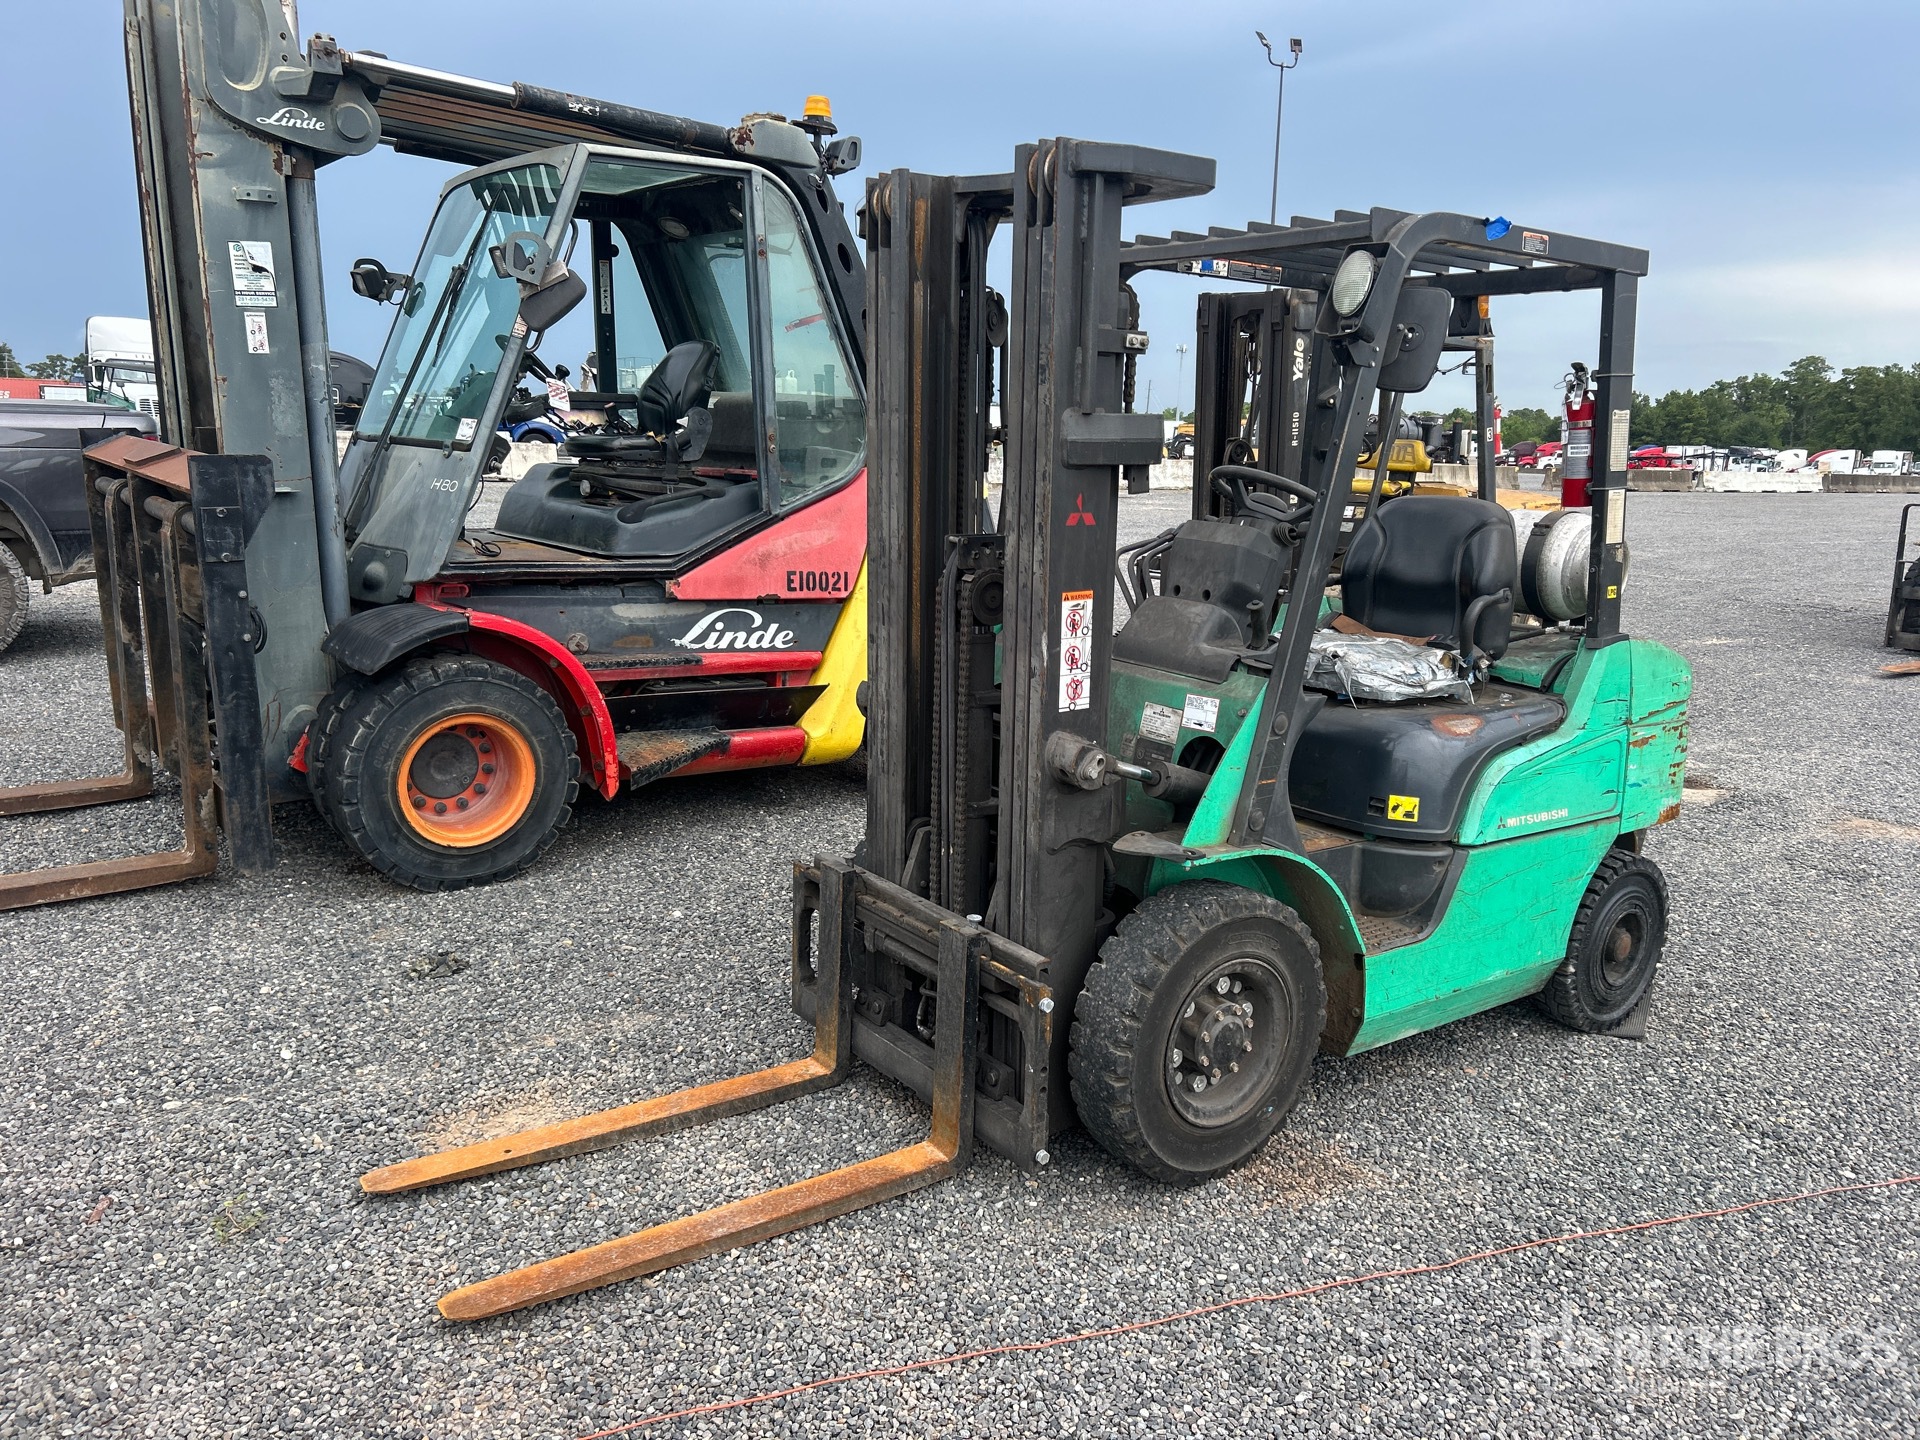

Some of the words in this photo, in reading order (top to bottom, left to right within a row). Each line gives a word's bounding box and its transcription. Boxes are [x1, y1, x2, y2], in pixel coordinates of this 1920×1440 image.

[256, 107, 325, 131] Linde
[1292, 338, 1305, 381] Yale
[430, 478, 459, 492] H80
[786, 571, 849, 593] E10021
[1070, 593, 1093, 601] WARNING
[669, 608, 794, 650] Linde
[1507, 808, 1568, 827] MITSUBISHI
